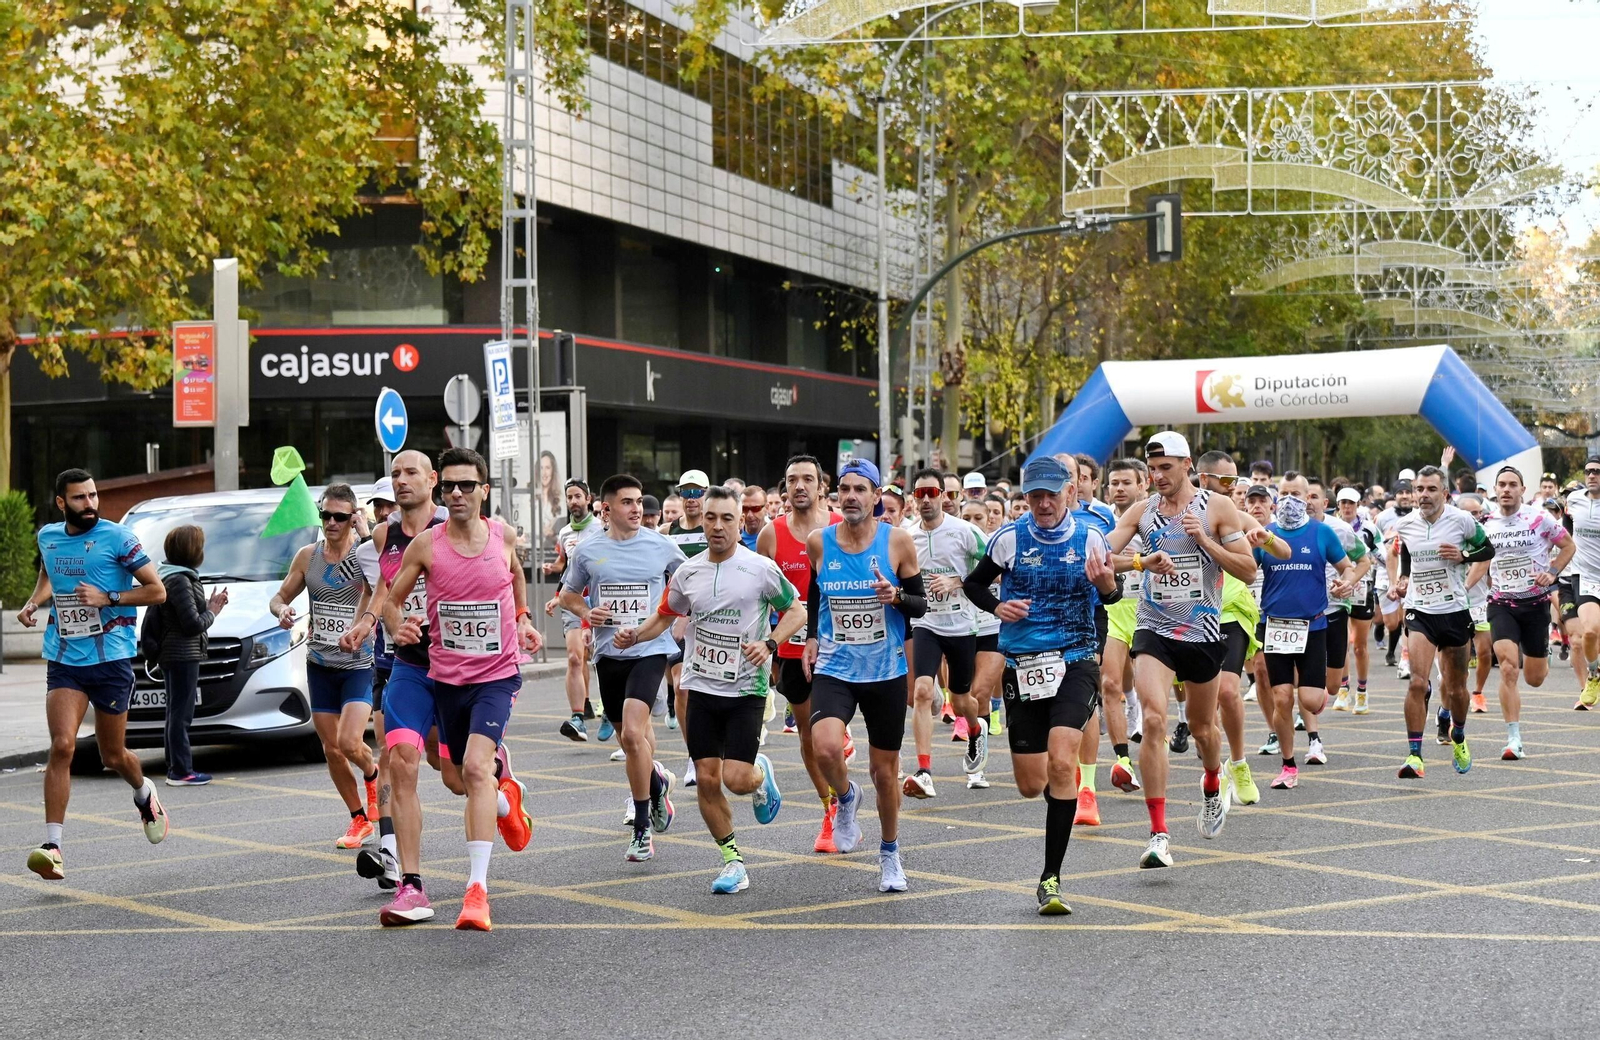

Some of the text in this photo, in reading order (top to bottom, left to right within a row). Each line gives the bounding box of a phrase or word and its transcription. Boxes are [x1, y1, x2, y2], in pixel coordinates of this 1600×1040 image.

[260, 345, 390, 384] cajasur
[1255, 374, 1347, 393] Diputación
[1254, 392, 1349, 408] de Córdoba
[1514, 540, 1534, 548] TRAIL
[1159, 571, 1191, 588] 488
[1506, 568, 1527, 581] 590
[823, 580, 879, 591] TROTASIER
[1420, 581, 1443, 596] 553
[610, 599, 640, 614] 414
[62, 608, 89, 624] 518
[841, 613, 874, 629] 669
[319, 617, 345, 633] 388
[452, 620, 487, 638] 316
[1273, 630, 1299, 643] 610
[699, 646, 728, 665] 410
[1027, 666, 1056, 686] 635
